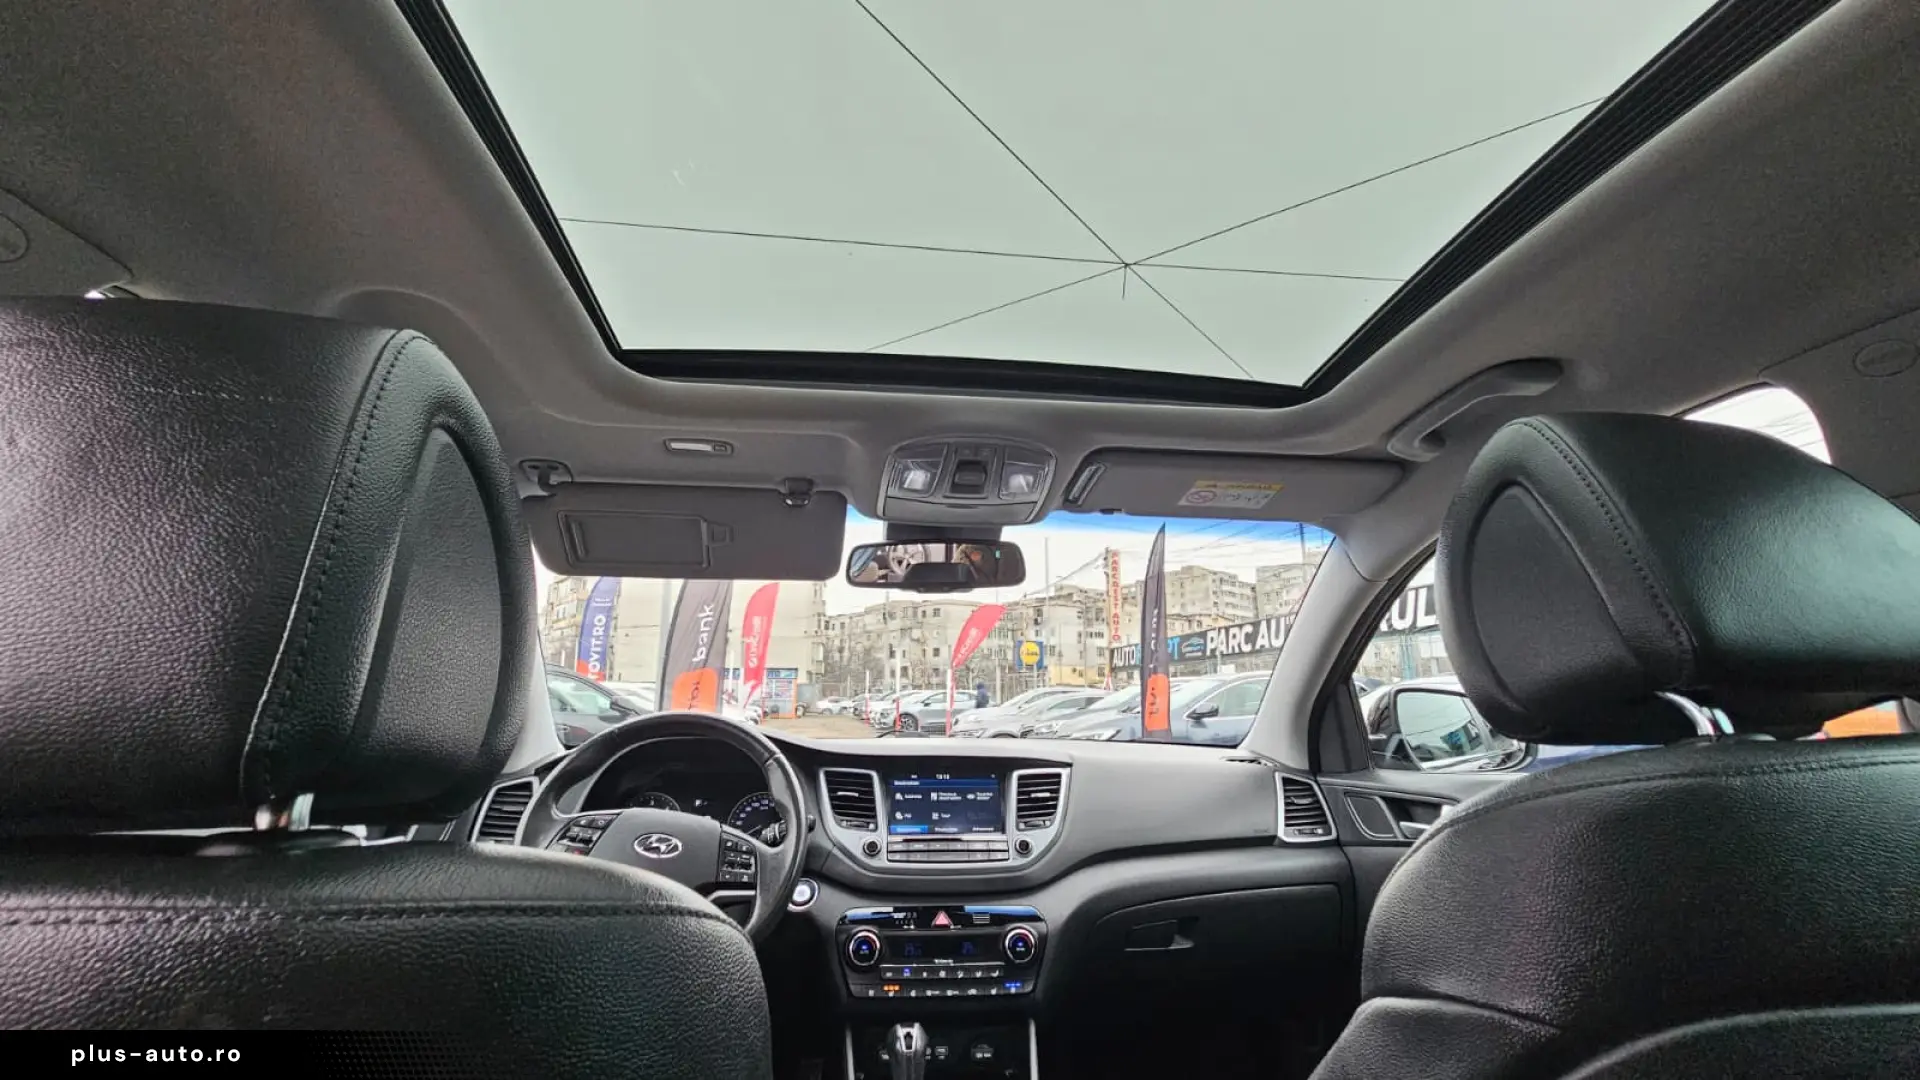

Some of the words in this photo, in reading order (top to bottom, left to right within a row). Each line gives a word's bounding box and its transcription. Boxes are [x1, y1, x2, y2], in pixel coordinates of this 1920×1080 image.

[692, 603, 714, 662] bank
[1206, 624, 1254, 657] PARC
[1255, 615, 1297, 650] AU
